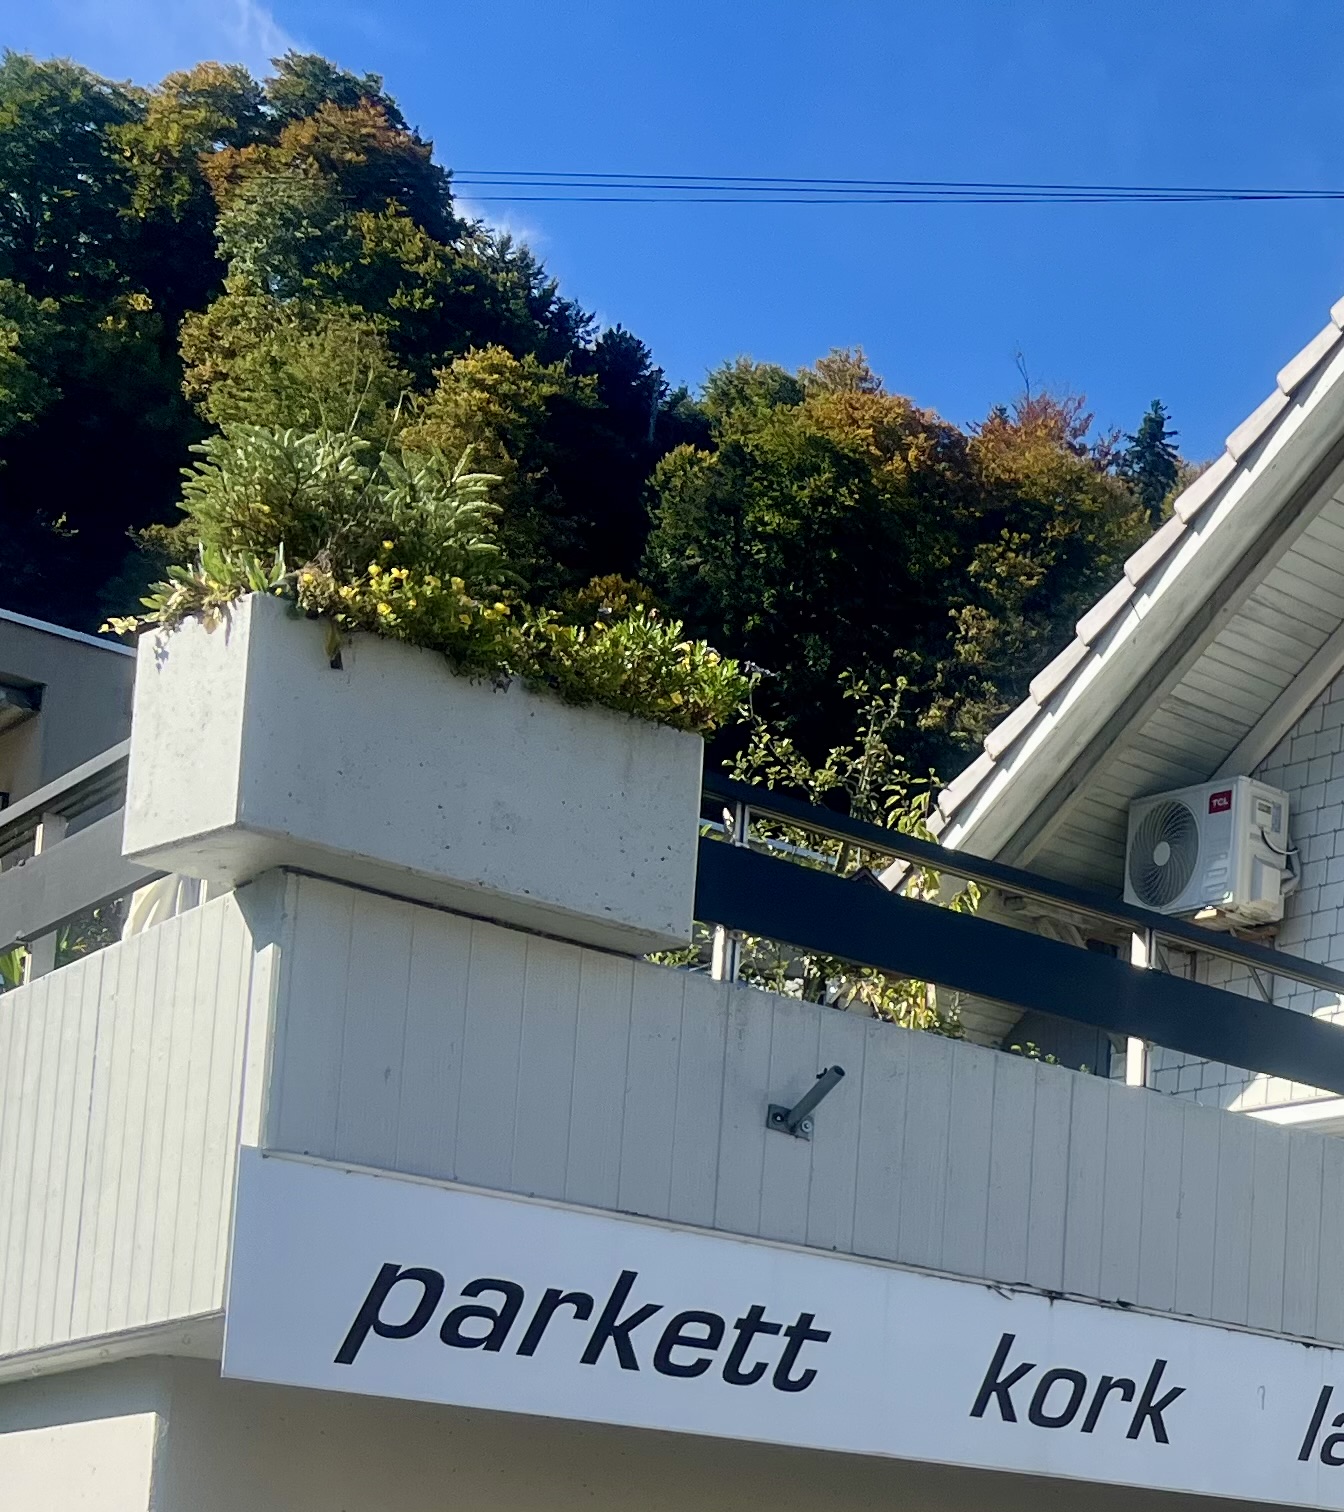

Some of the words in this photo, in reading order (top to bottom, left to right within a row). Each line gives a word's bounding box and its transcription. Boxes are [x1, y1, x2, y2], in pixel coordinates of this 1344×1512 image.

[1211, 796, 1229, 807] TCL
[333, 1260, 832, 1393] parkett
[969, 1332, 1187, 1444] kork
